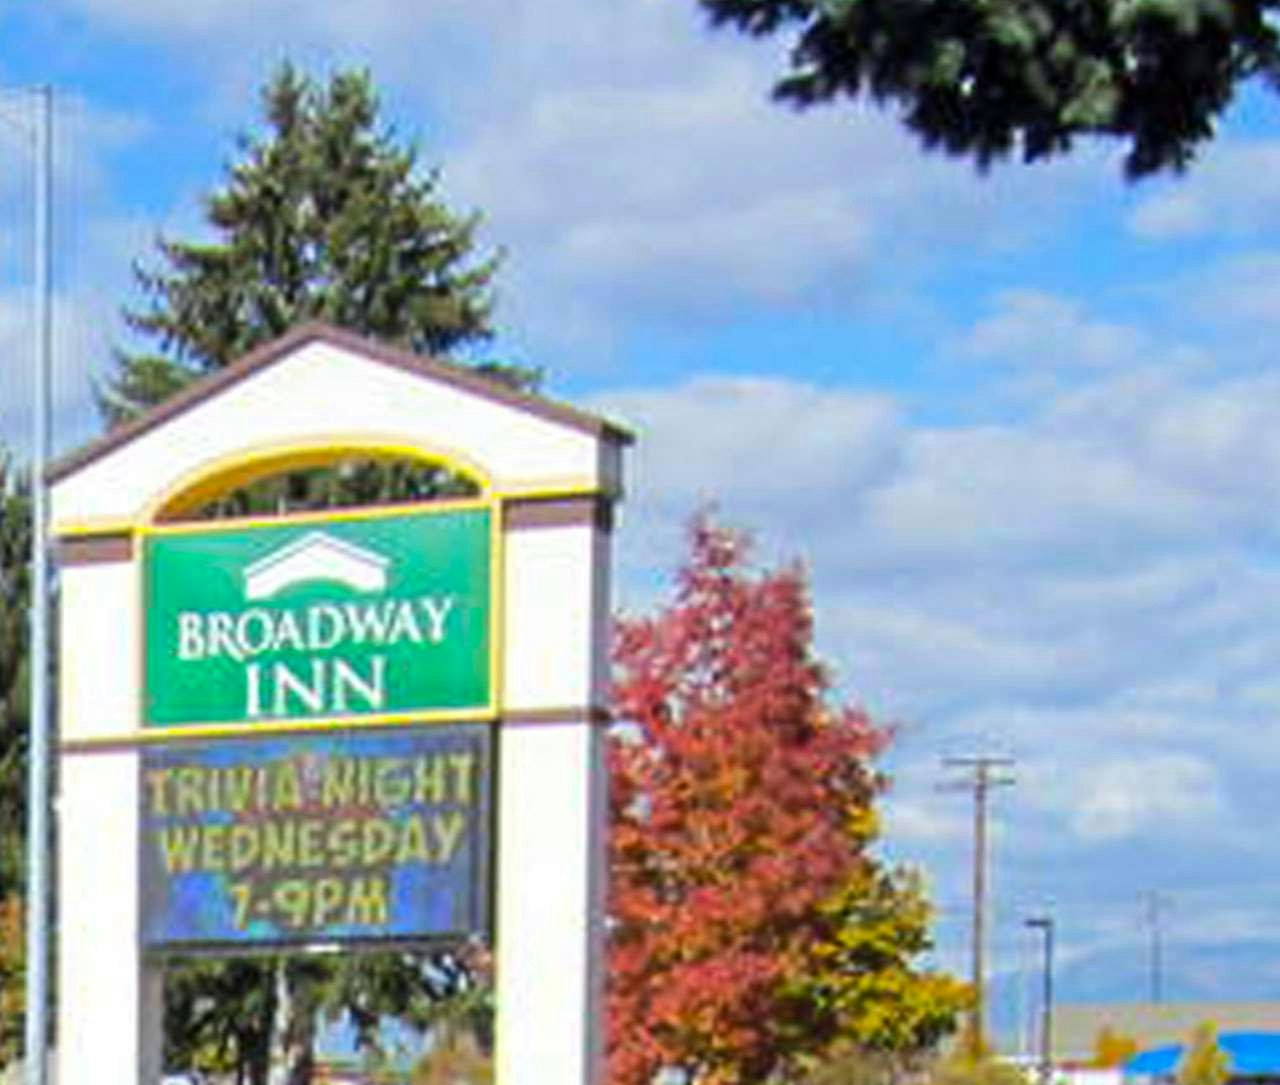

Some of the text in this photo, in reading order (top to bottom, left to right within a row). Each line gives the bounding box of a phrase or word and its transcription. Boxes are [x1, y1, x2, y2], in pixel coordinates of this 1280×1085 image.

[178, 597, 452, 661] BROADWAY
[244, 656, 386, 717] INN
[162, 813, 464, 873] WEDNESDAY
